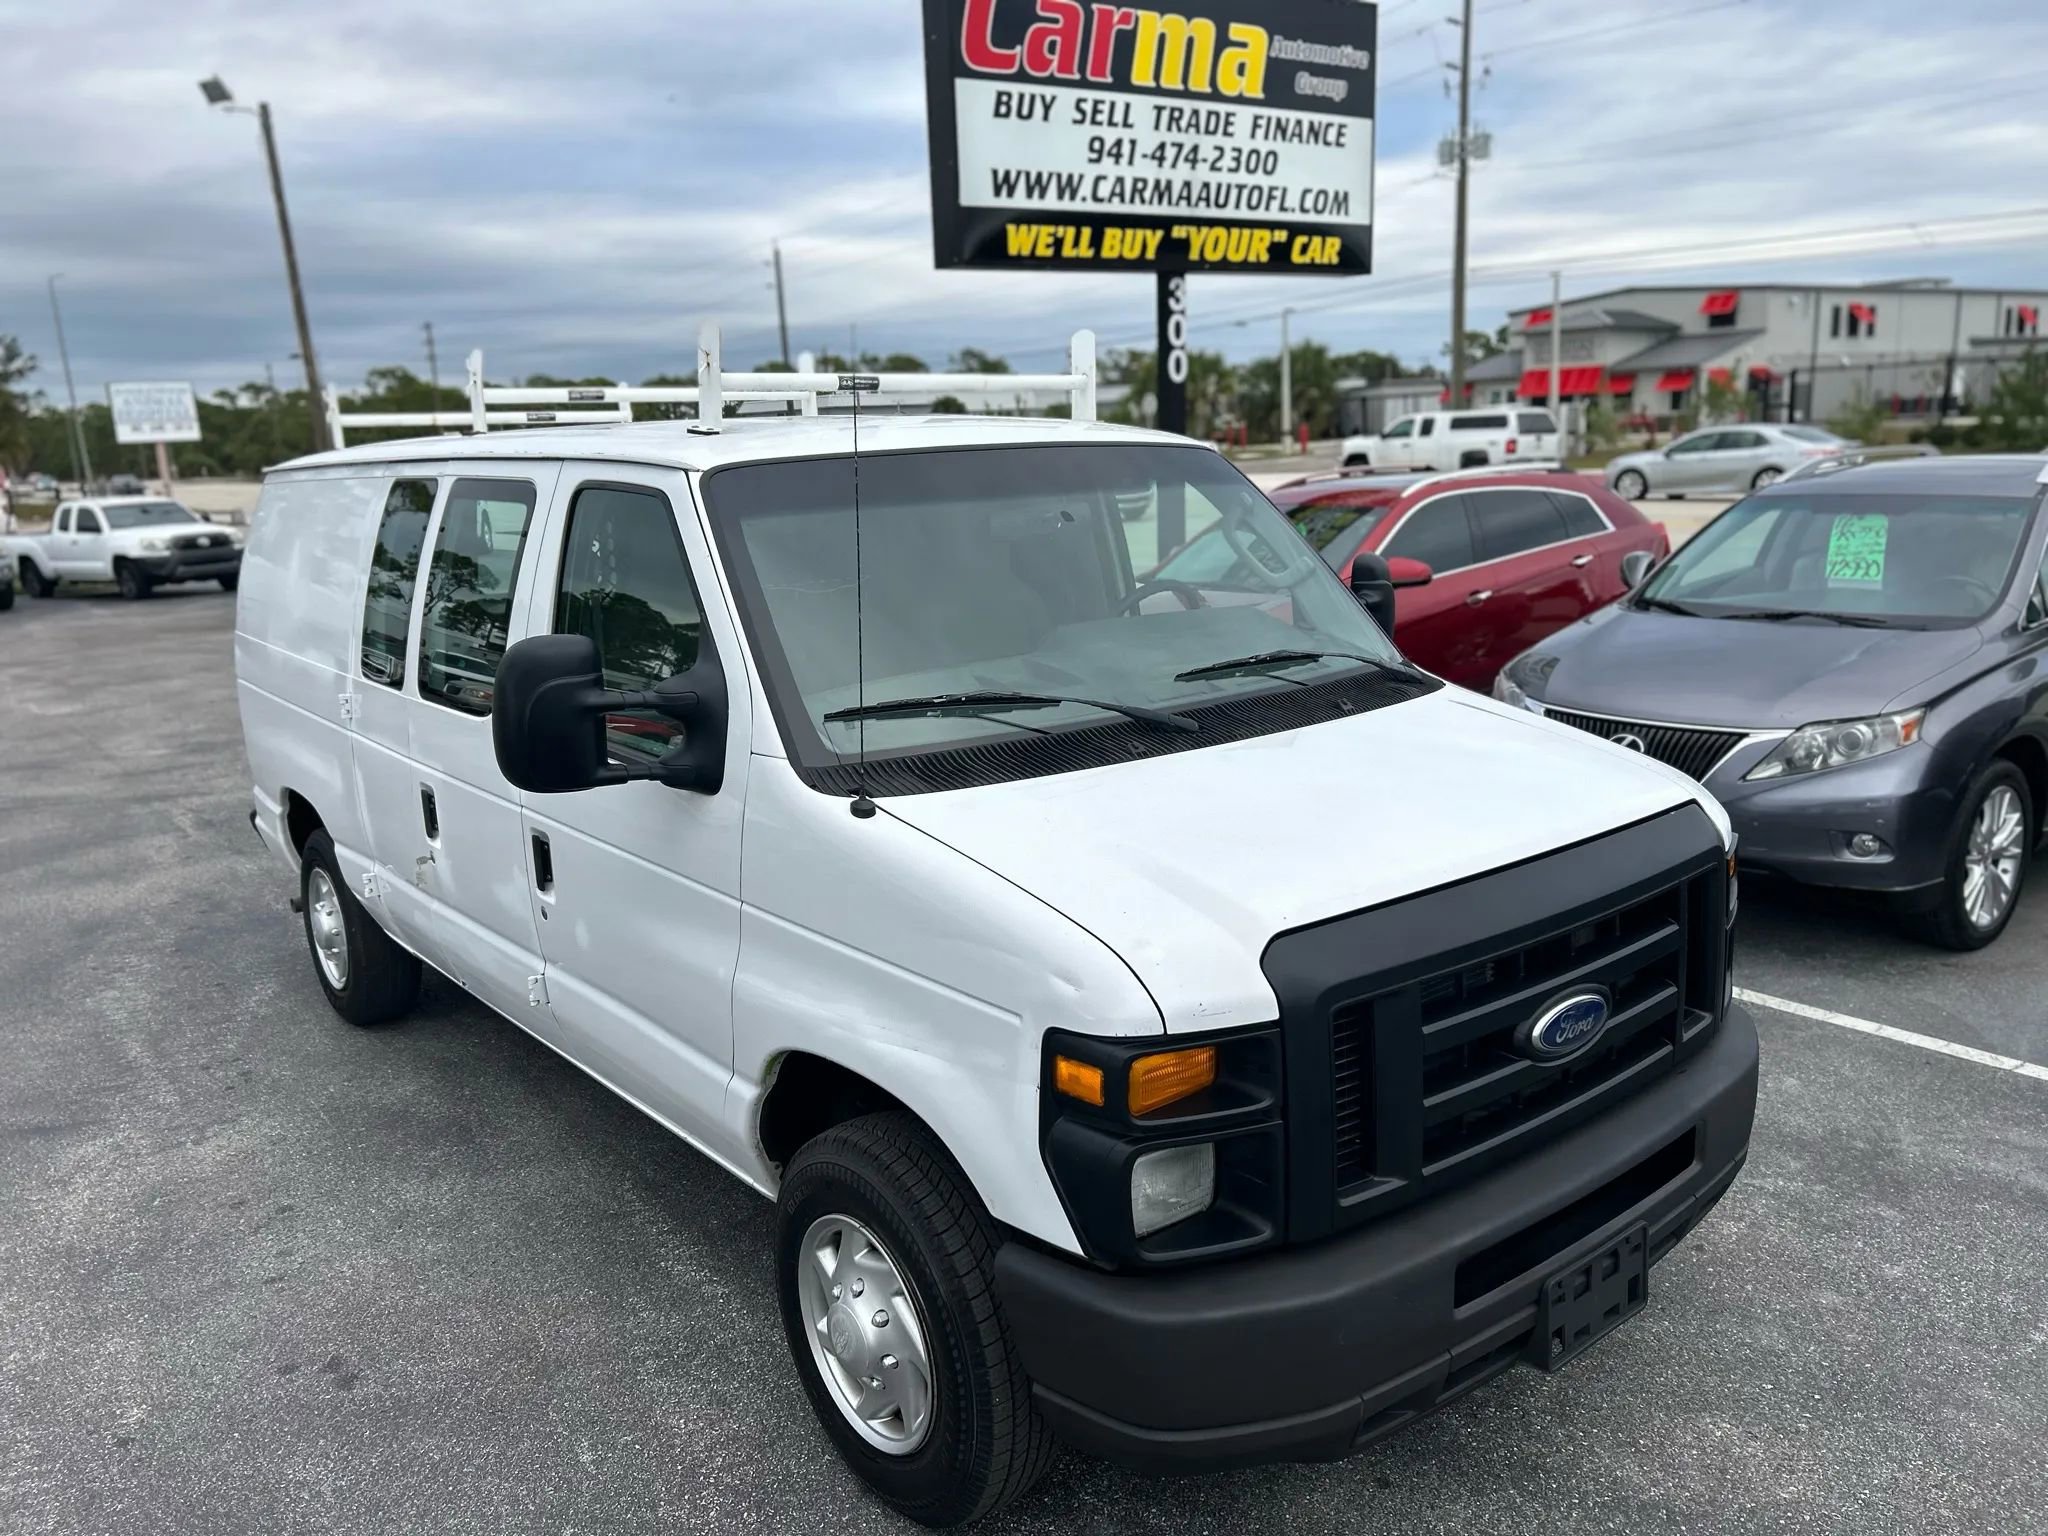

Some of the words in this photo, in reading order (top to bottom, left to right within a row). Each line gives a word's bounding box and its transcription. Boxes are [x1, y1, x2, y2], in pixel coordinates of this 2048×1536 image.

[961, 0, 1269, 98] Carma
[1269, 35, 1370, 70] Automotive
[1294, 71, 1348, 102] Group
[993, 90, 1057, 122] BUY
[1072, 97, 1134, 129] SELL
[1152, 105, 1236, 138] TRADE
[1250, 114, 1348, 148] FINANCE
[1087, 136, 1279, 176] 941-474-2300
[991, 168, 1350, 217] WWW.CARMAAUTOFL.COM
[1005, 223, 1095, 258] WE'LL
[1100, 227, 1164, 261] BUY
[1171, 225, 1288, 264] "YOUR"
[1291, 235, 1342, 265] CAR
[1167, 276, 1189, 384] 300
[1555, 1011, 1595, 1043] Ford
